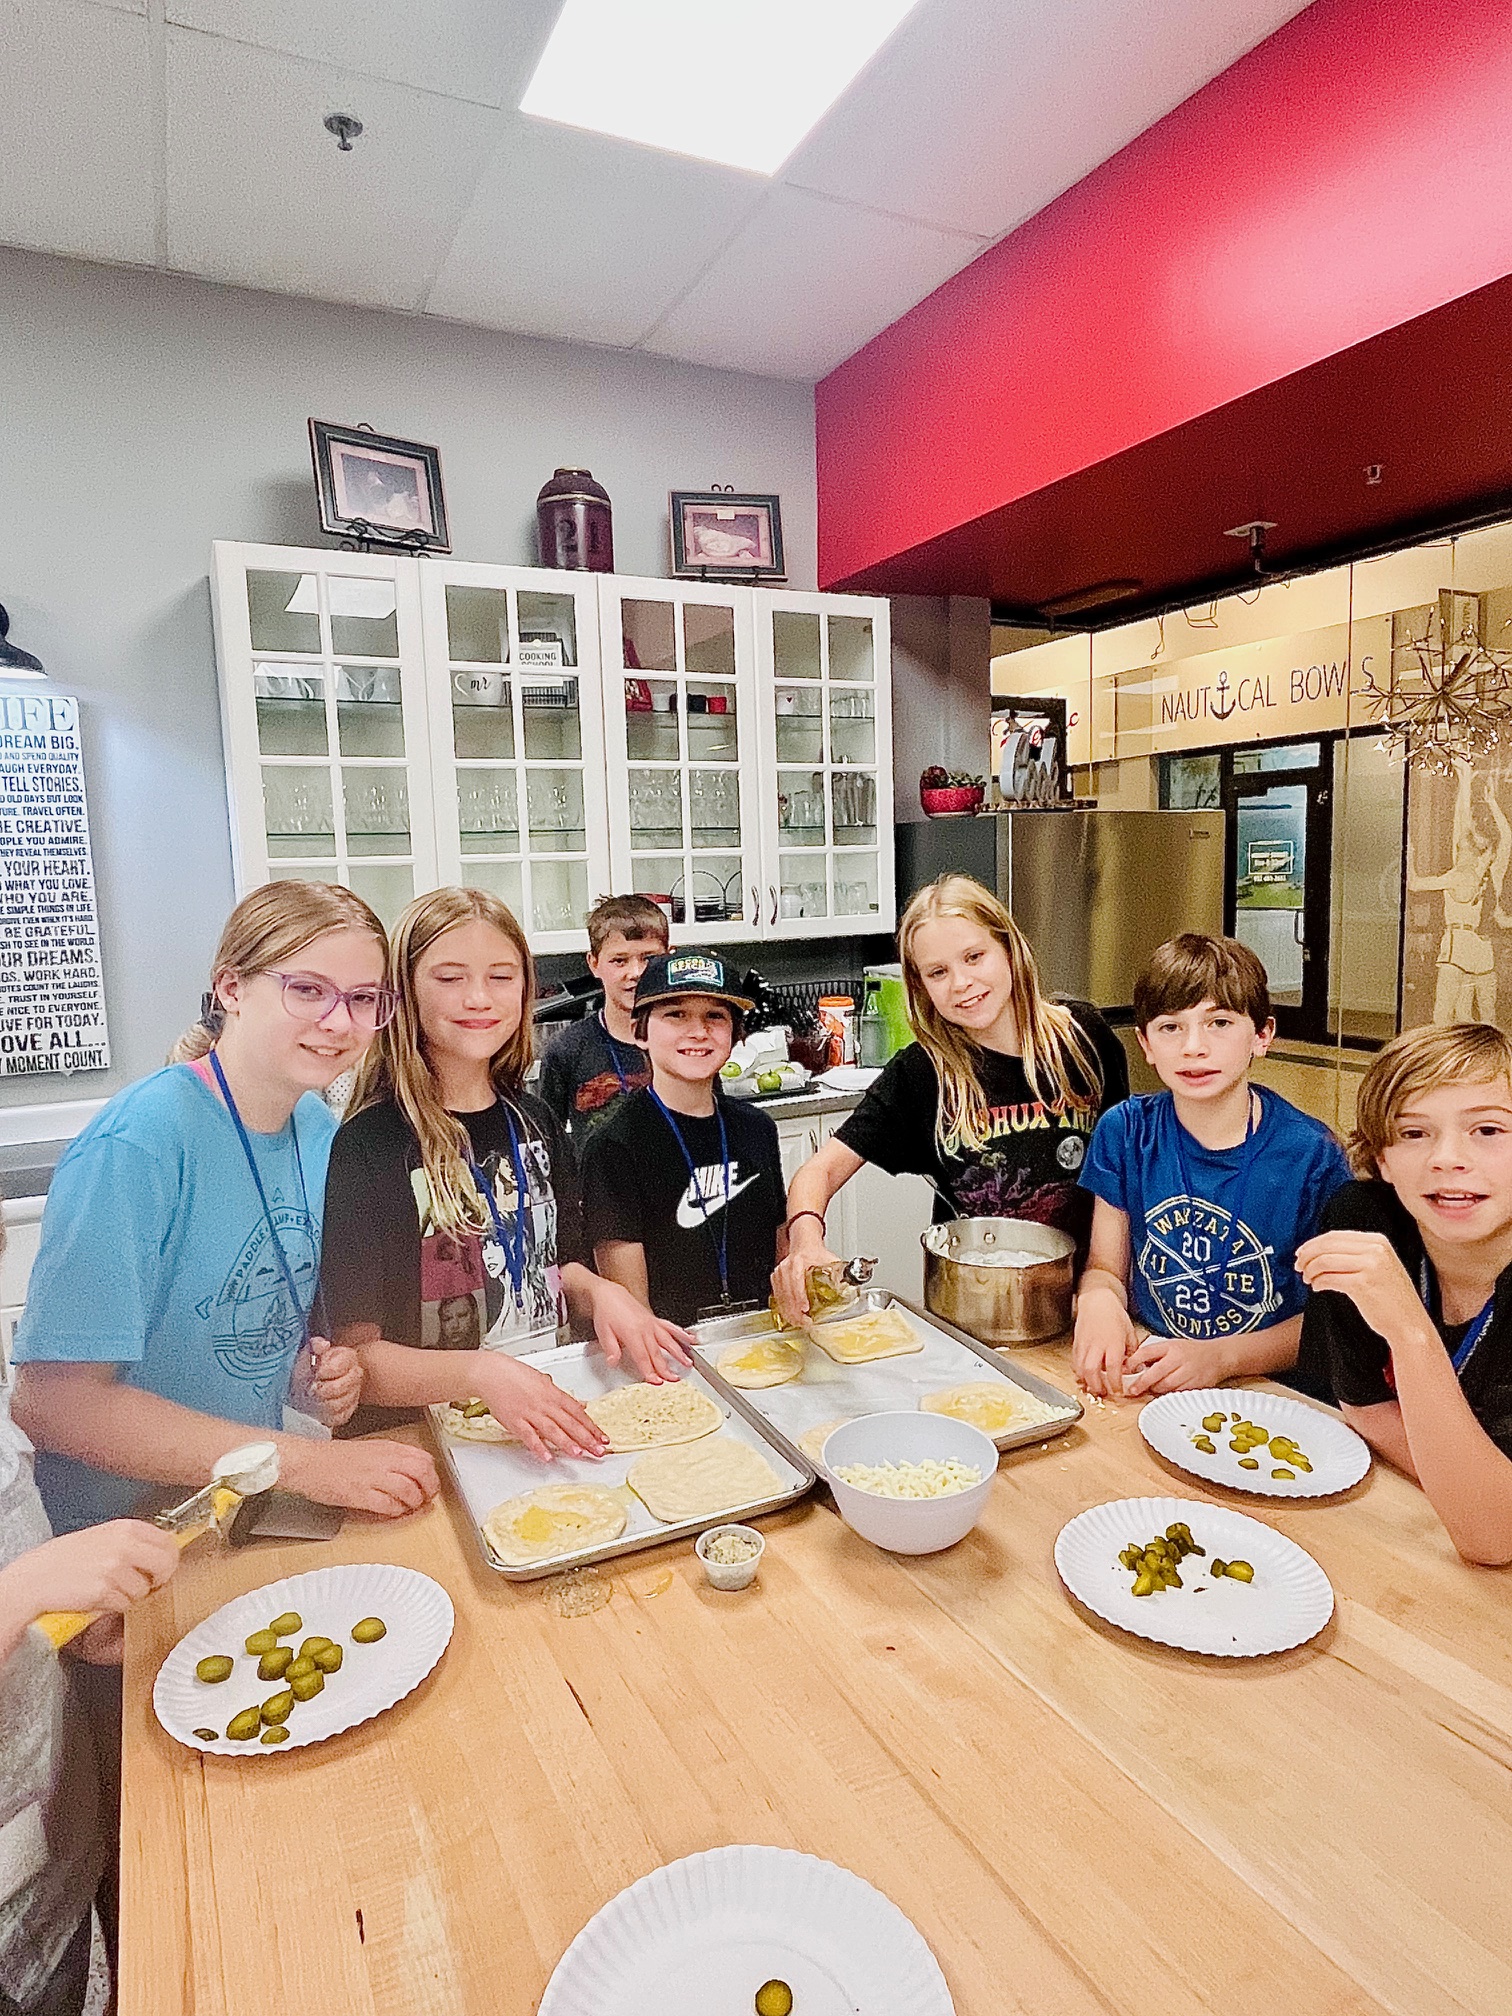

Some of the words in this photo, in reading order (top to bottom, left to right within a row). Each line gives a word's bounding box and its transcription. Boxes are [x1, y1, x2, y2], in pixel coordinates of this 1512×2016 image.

[519, 652, 556, 661] COOKING
[1290, 656, 1374, 703] BOWS
[51, 736, 79, 750] BIG.
[4, 752, 20, 760] AND
[22, 752, 47, 760] SPEND
[48, 752, 79, 761] QUALITY
[1, 776, 30, 792] TELL
[32, 776, 83, 792] STORIES.
[7, 794, 22, 804] OLD
[24, 794, 45, 803] DAYS
[47, 794, 61, 803] BUT
[63, 794, 84, 803] LOOK
[22, 806, 54, 816] TRAVEL
[55, 806, 85, 816] OFTEN.
[16, 819, 87, 833] CREATIVE.
[26, 837, 46, 845] YOU
[48, 836, 87, 845] ADMIRE.
[16, 848, 41, 857] REVEAL
[4, 860, 40, 877] YOUR
[43, 859, 90, 876] HEART.
[5, 879, 35, 891] WHAT
[38, 879, 59, 890] YOU
[28, 892, 57, 904] YOU
[61, 891, 93, 902] ARE.
[6, 905, 35, 914] SIMPLE
[37, 904, 65, 913] THINGS
[66, 904, 74, 912] IN
[4, 926, 22, 938] BE
[13, 941, 23, 949] TO
[25, 940, 39, 948] SEE
[41, 939, 49, 947] IN
[50, 938, 66, 947] THE
[27, 948, 98, 967] DREAMS.
[23, 969, 61, 981] WORK
[63, 967, 100, 979] HARD.
[23, 983, 49, 991] COUNT
[51, 982, 66, 990] THE
[8, 994, 38, 1003] TRUST
[40, 994, 50, 1002] IN
[7, 1006, 30, 1015] NICE
[33, 1005, 46, 1013] TO
[48, 1001, 103, 1013] EVERYONE.
[27, 1016, 53, 1031] FOR
[55, 1013, 105, 1028] TODAY.
[6, 1053, 60, 1074] MOMENT
[64, 1049, 108, 1069] COUNT.
[686, 1161, 739, 1202] NIKE
[1181, 1231, 1211, 1262] 20
[1223, 1272, 1256, 1294] TE
[1175, 1283, 1211, 1314] 23
